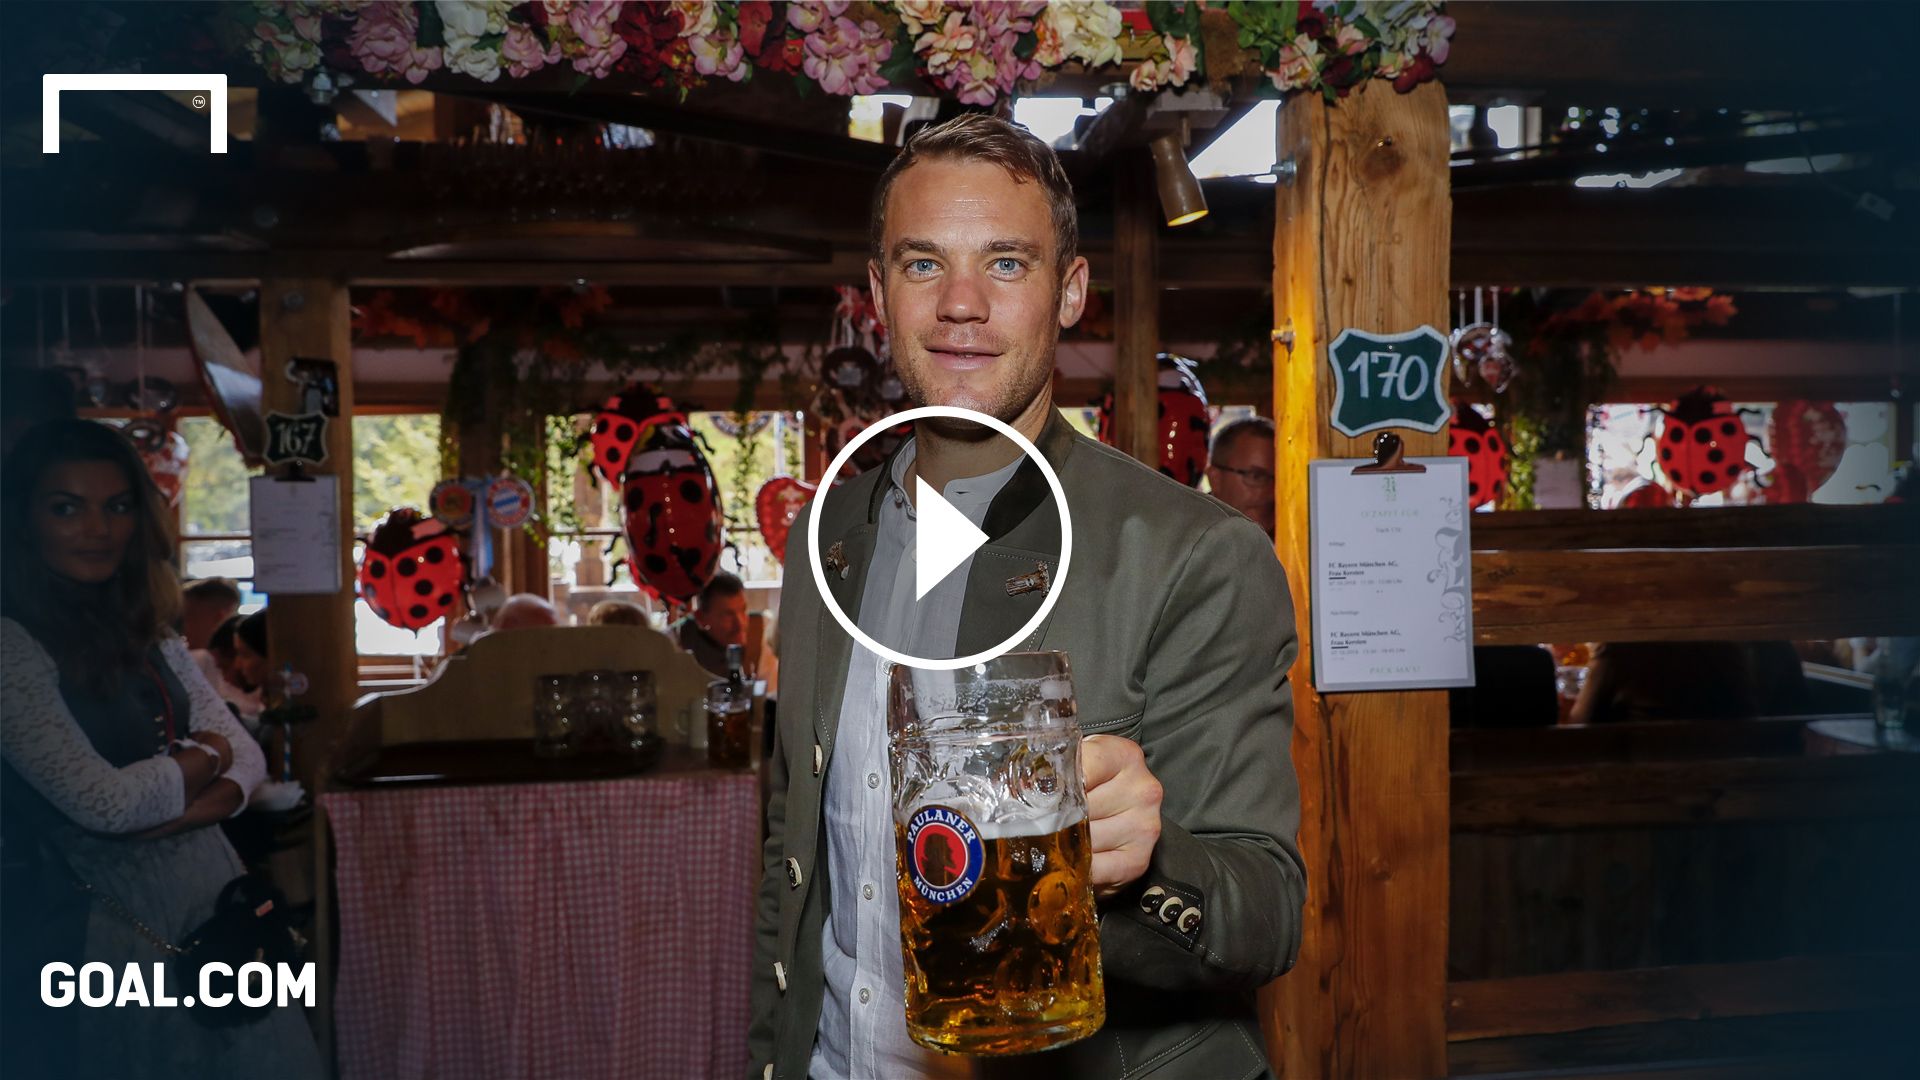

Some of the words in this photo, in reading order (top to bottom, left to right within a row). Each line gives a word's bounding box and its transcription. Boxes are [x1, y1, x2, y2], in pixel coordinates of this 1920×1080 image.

[1347, 351, 1429, 401] 170
[276, 422, 317, 455] 167
[907, 809, 977, 845] PAULANER
